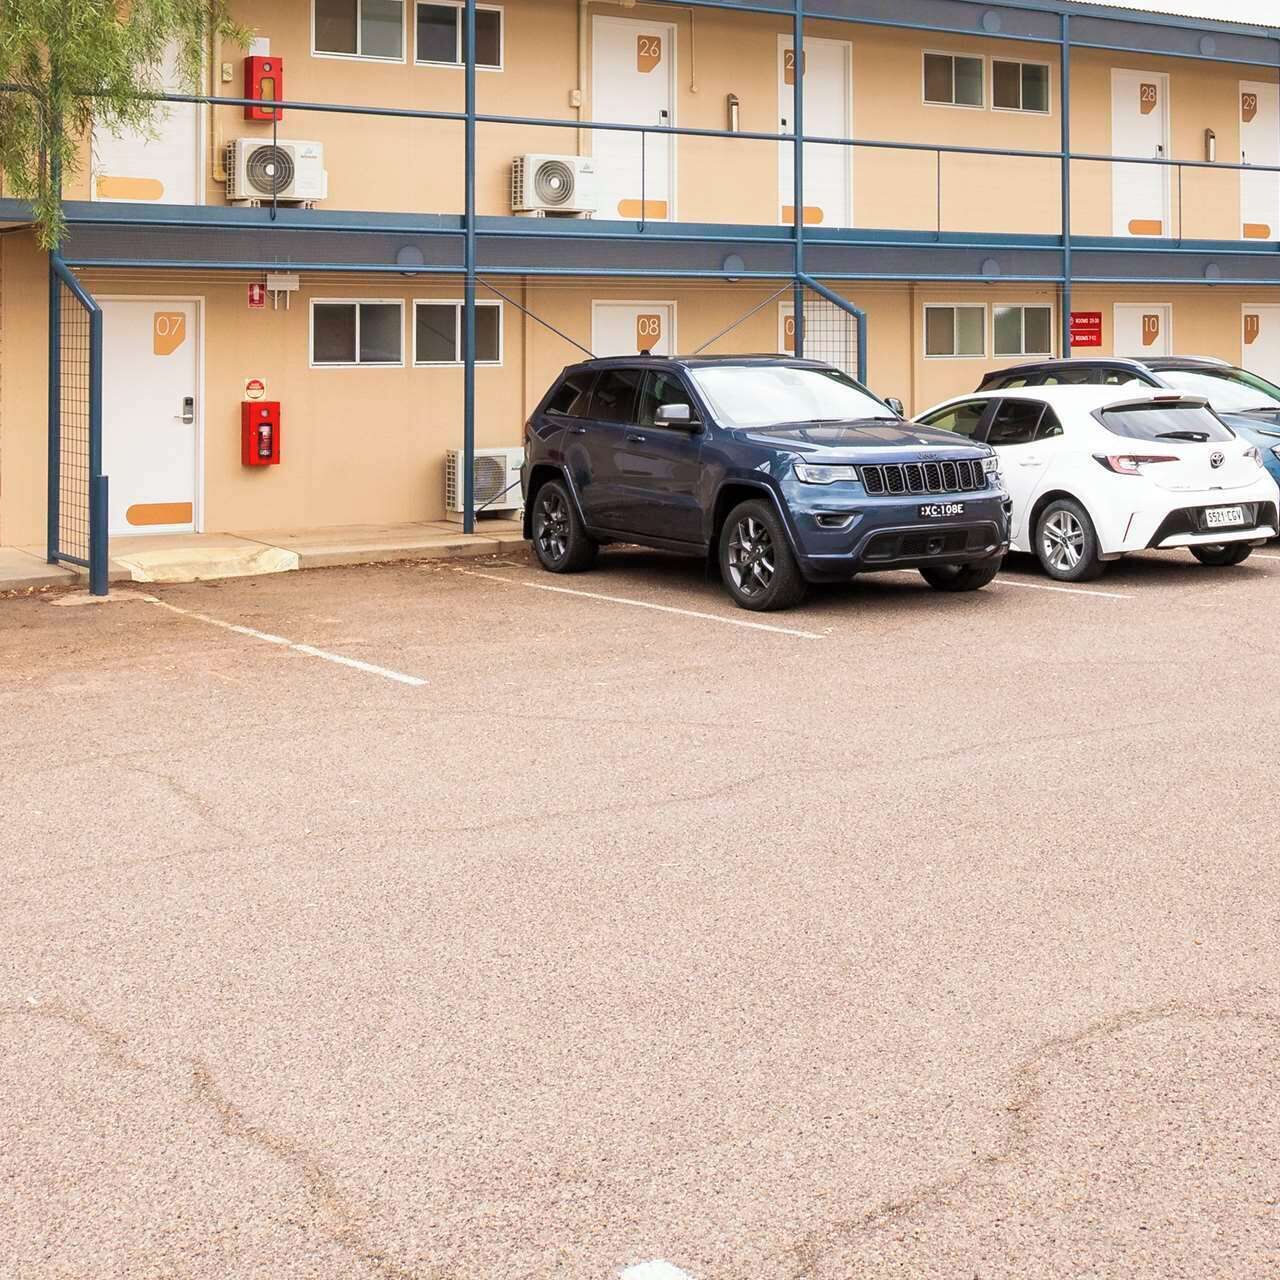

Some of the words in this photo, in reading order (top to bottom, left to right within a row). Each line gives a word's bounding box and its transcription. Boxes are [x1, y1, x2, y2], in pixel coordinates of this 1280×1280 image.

[639, 38, 660, 57] 26
[1141, 86, 1156, 102] 28
[1243, 95, 1257, 111] 29
[156, 315, 183, 337] 07
[638, 317, 660, 336] 08
[1144, 317, 1158, 333] 10
[1246, 317, 1258, 332] 11
